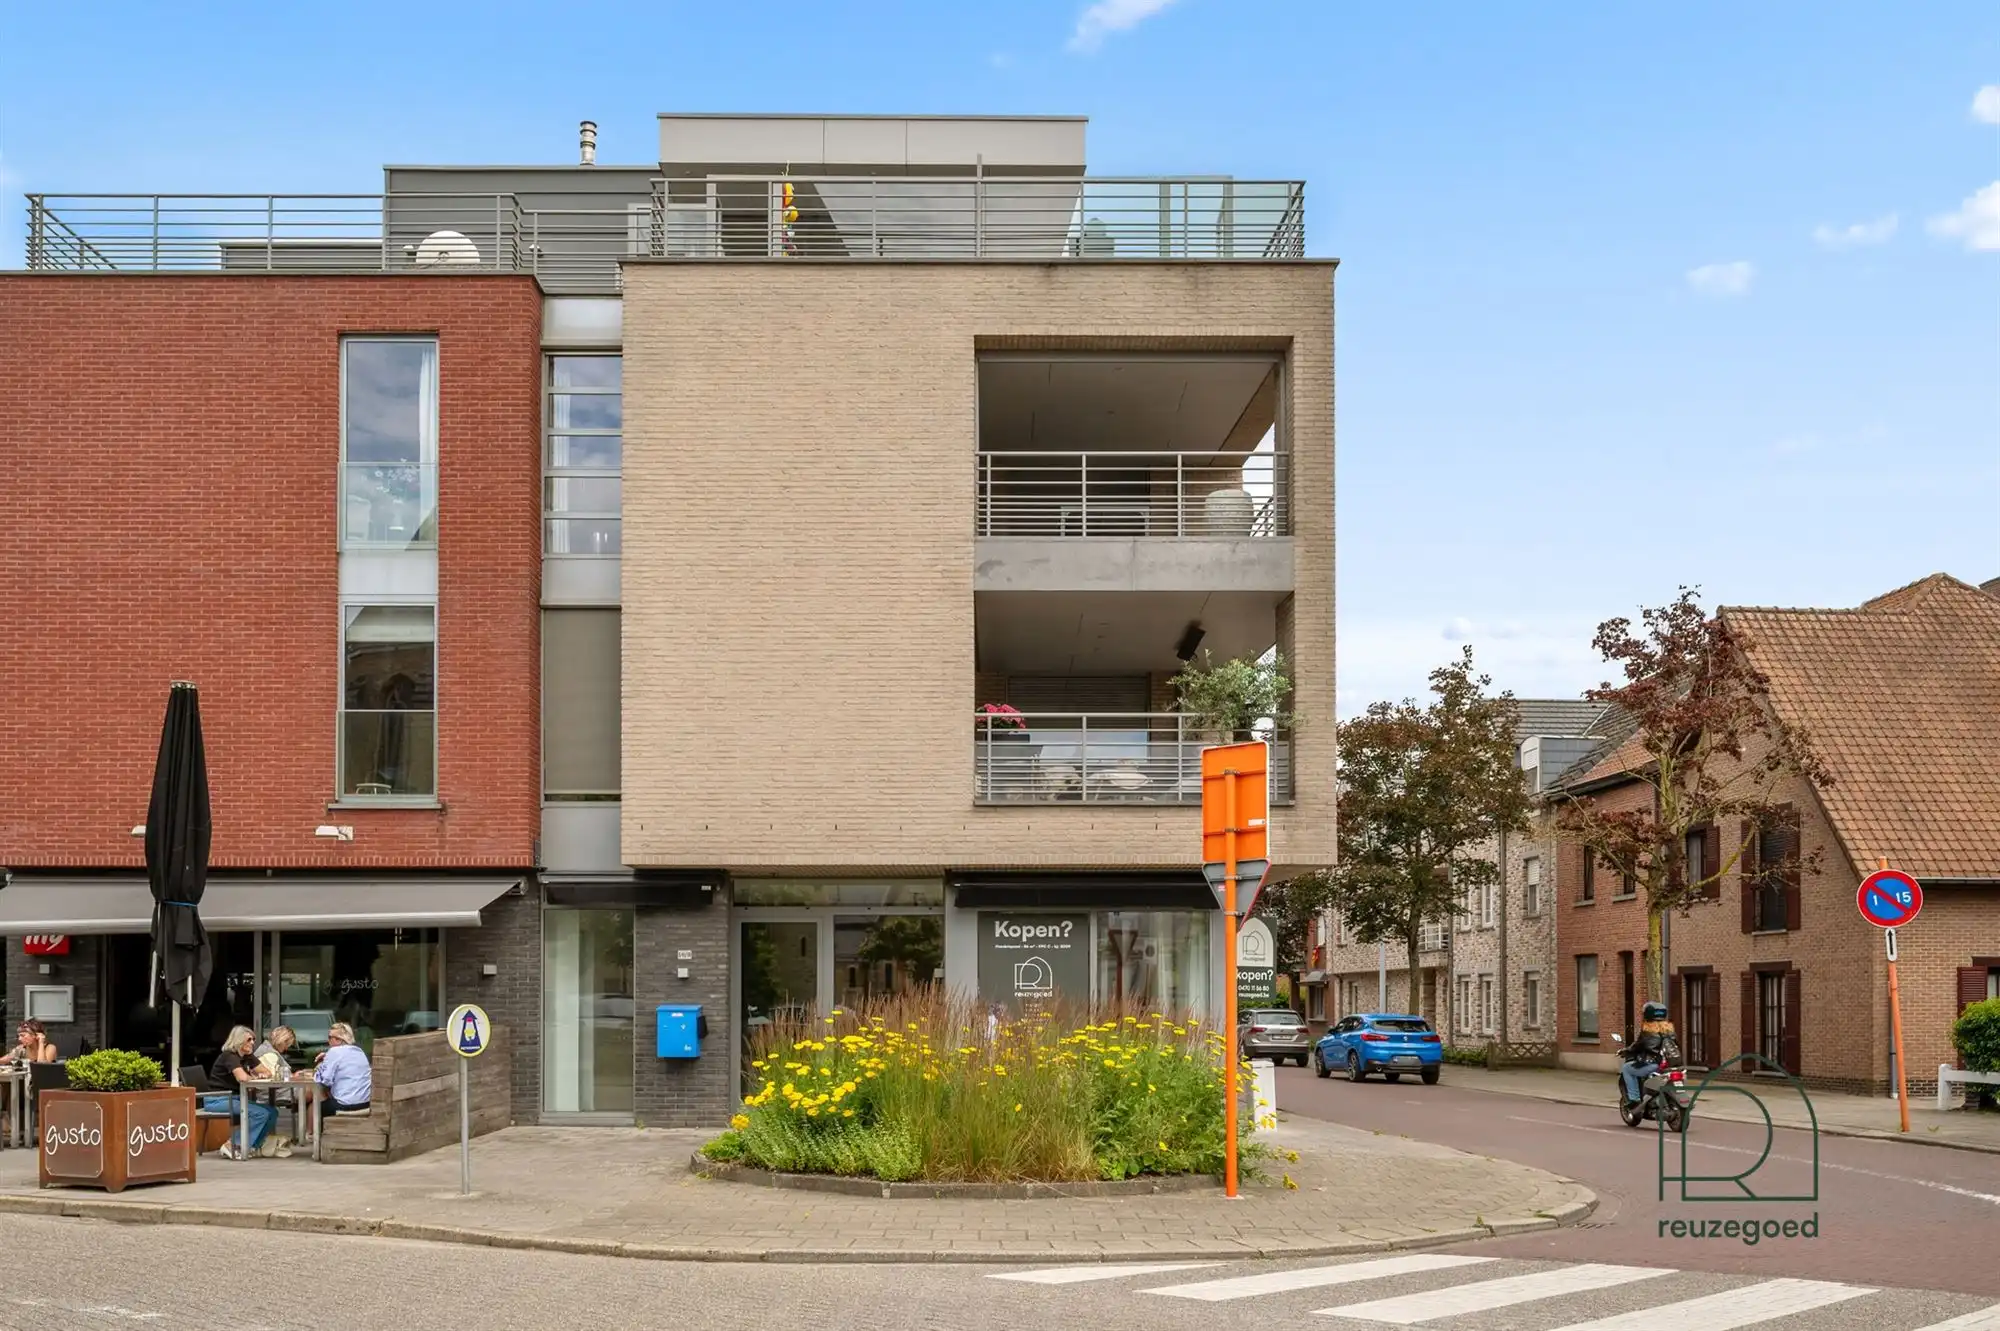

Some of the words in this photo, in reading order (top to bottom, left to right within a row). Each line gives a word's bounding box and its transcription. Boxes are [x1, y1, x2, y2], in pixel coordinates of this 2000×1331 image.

[1895, 891, 1912, 903] 15
[994, 920, 1073, 942] Kopen?
[341, 977, 380, 995] gusto
[45, 1122, 101, 1155] gusto
[129, 1118, 189, 1156] gusto
